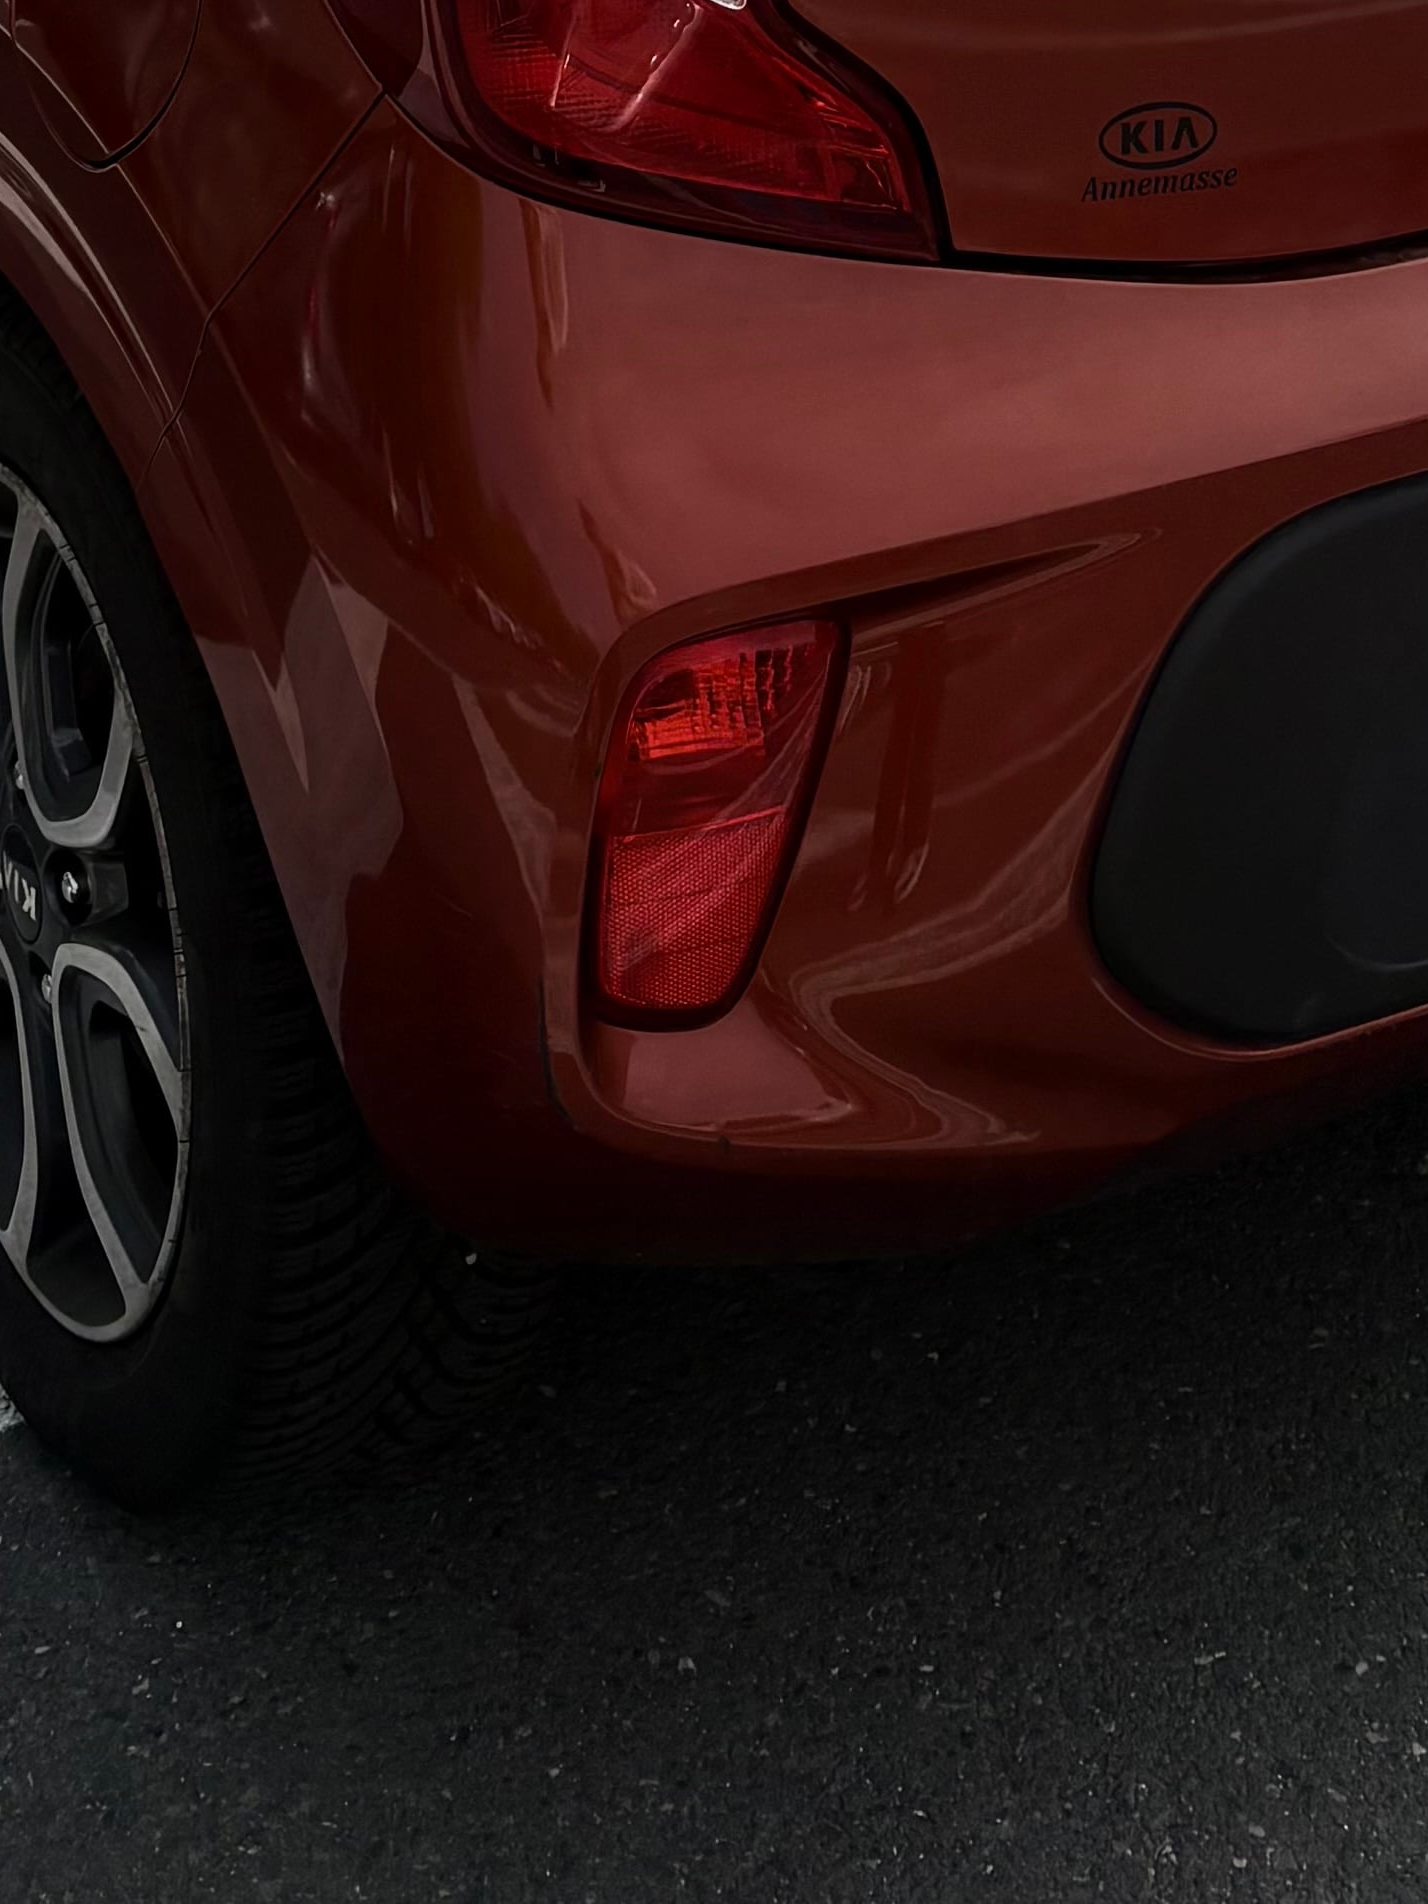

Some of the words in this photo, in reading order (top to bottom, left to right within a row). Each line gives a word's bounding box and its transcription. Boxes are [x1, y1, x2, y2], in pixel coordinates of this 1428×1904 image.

[1121, 116, 1199, 155] KIA
[1080, 167, 1238, 203] Annemasse
[3, 849, 37, 921] KIA
